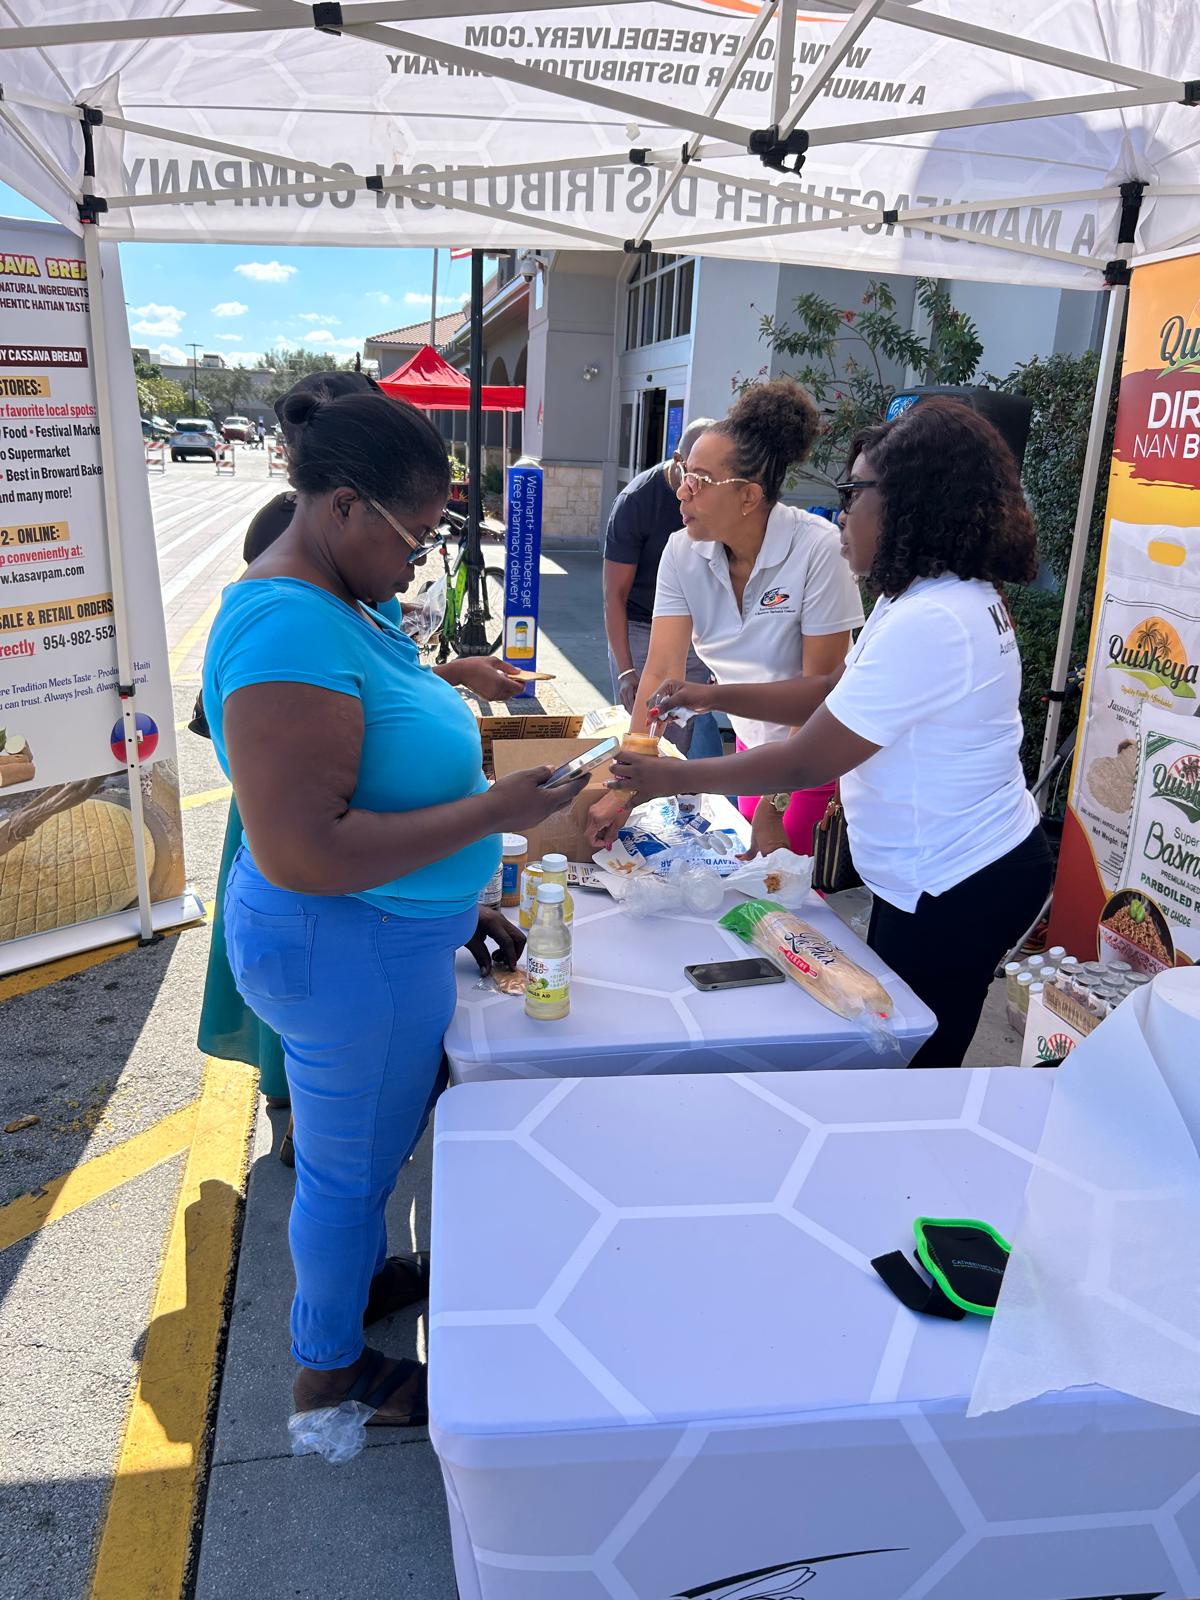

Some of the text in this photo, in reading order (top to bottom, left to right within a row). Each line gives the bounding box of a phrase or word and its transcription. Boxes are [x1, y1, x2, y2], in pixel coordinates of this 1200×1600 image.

[45, 257, 90, 281] BREA
[38, 285, 89, 298] INGREDIENTS
[32, 300, 65, 311] HAITIAN
[66, 302, 90, 312] TASTE
[8, 349, 52, 361] CASSAVA
[52, 351, 82, 362] BREAD!
[5, 403, 45, 417] favorite
[45, 403, 69, 416] local
[70, 404, 97, 418] spots:
[2, 425, 28, 439] Food
[35, 424, 72, 438] Festival
[8, 445, 71, 462] Supermarket
[1133, 433, 1178, 459] NAN
[6, 467, 30, 482] Best
[30, 467, 40, 480] in
[41, 465, 80, 479] Broward
[16, 491, 44, 504] many
[45, 487, 72, 500] more!
[0, 525, 60, 545] 2- ONLINE:
[509, 475, 524, 604] free pharmacy delivery
[522, 475, 537, 609] Walmart+ members get
[7, 546, 69, 564] conveniently
[71, 544, 83, 557] at:
[27, 611, 36, 626] &
[38, 605, 75, 625] RETAIL
[76, 598, 114, 618] ORDERS
[43, 623, 116, 651] 954-982-552
[1108, 634, 1199, 690] Quiskeya
[12, 680, 48, 694] Tradition
[48, 676, 72, 689] Meets
[73, 674, 92, 684] Taste
[4, 701, 20, 710] can
[21, 696, 42, 706] trust.
[44, 691, 73, 703] Always
[1107, 699, 1138, 719] Jasmine
[1160, 869, 1185, 887] PREMIUM
[1140, 872, 1192, 909] PARBOILED
